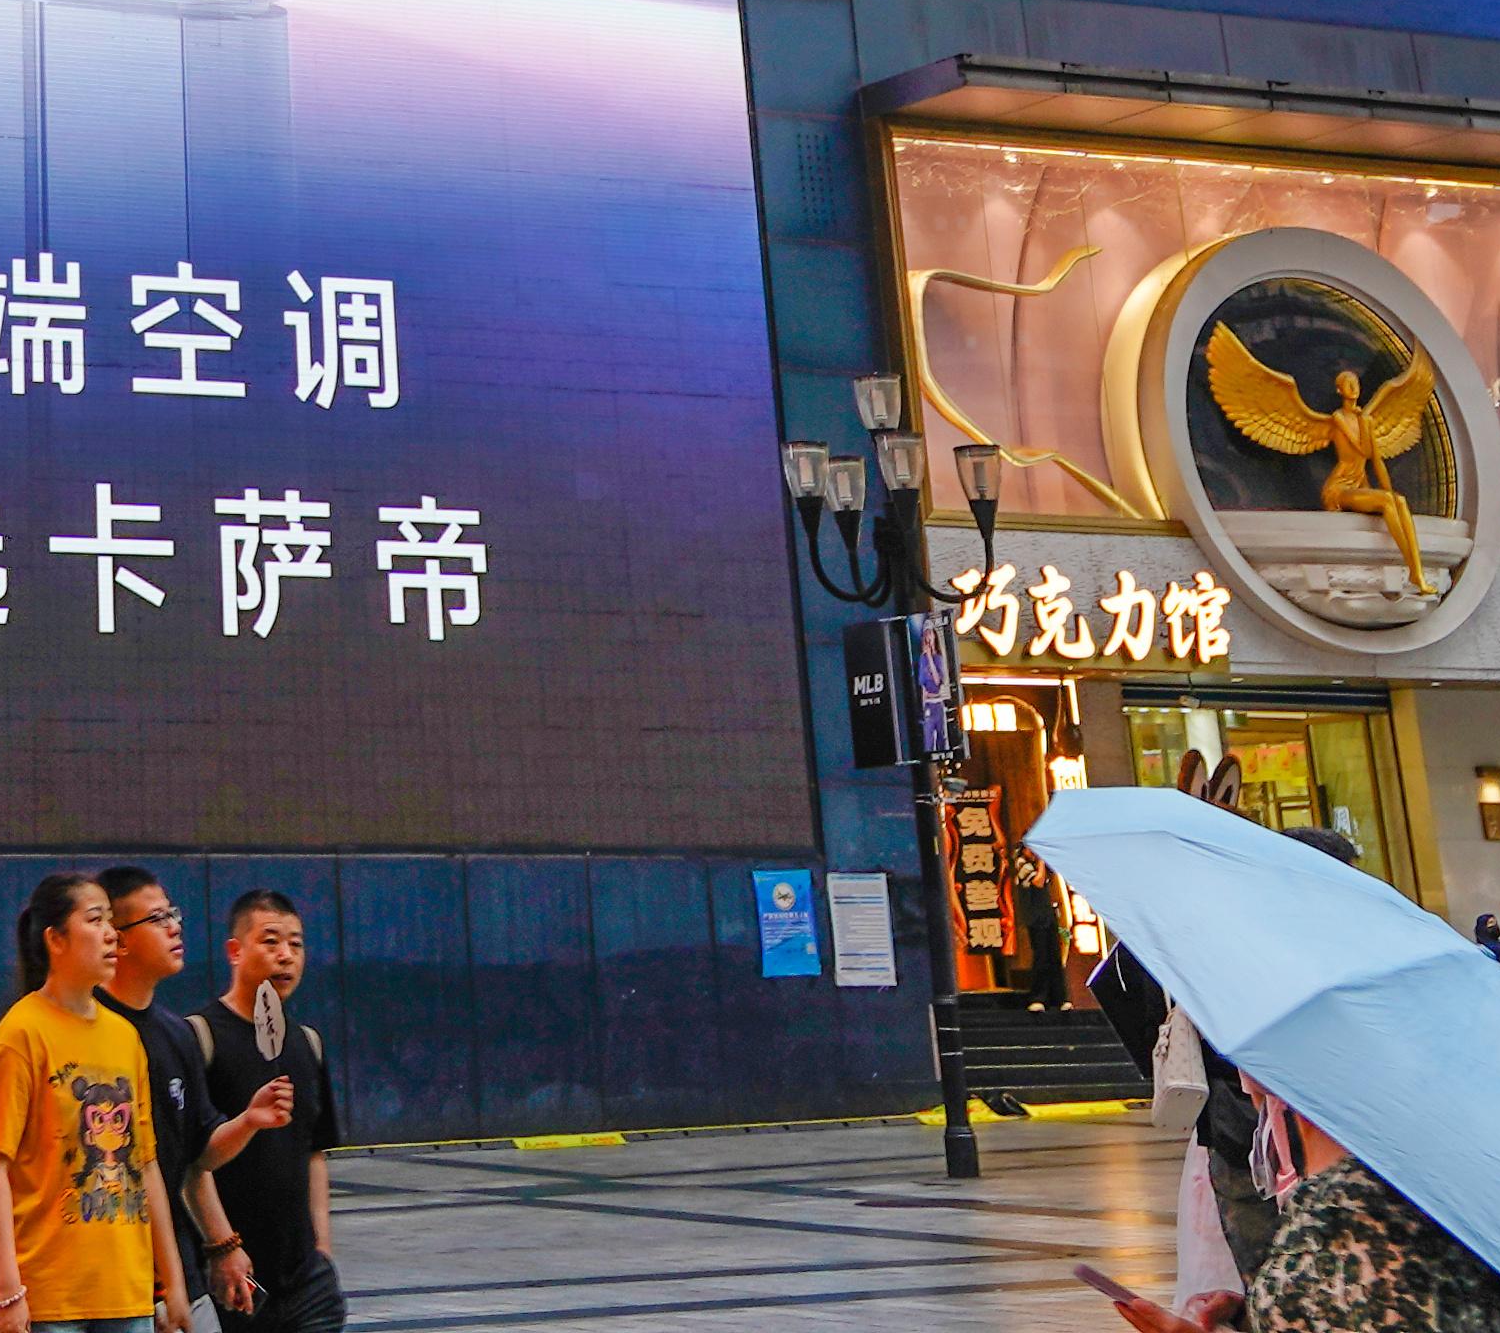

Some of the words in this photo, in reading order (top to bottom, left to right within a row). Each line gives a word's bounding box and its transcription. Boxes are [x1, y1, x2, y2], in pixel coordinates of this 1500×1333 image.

[951, 563, 1232, 665] 巧克力馆
[853, 672, 885, 696] MLB
